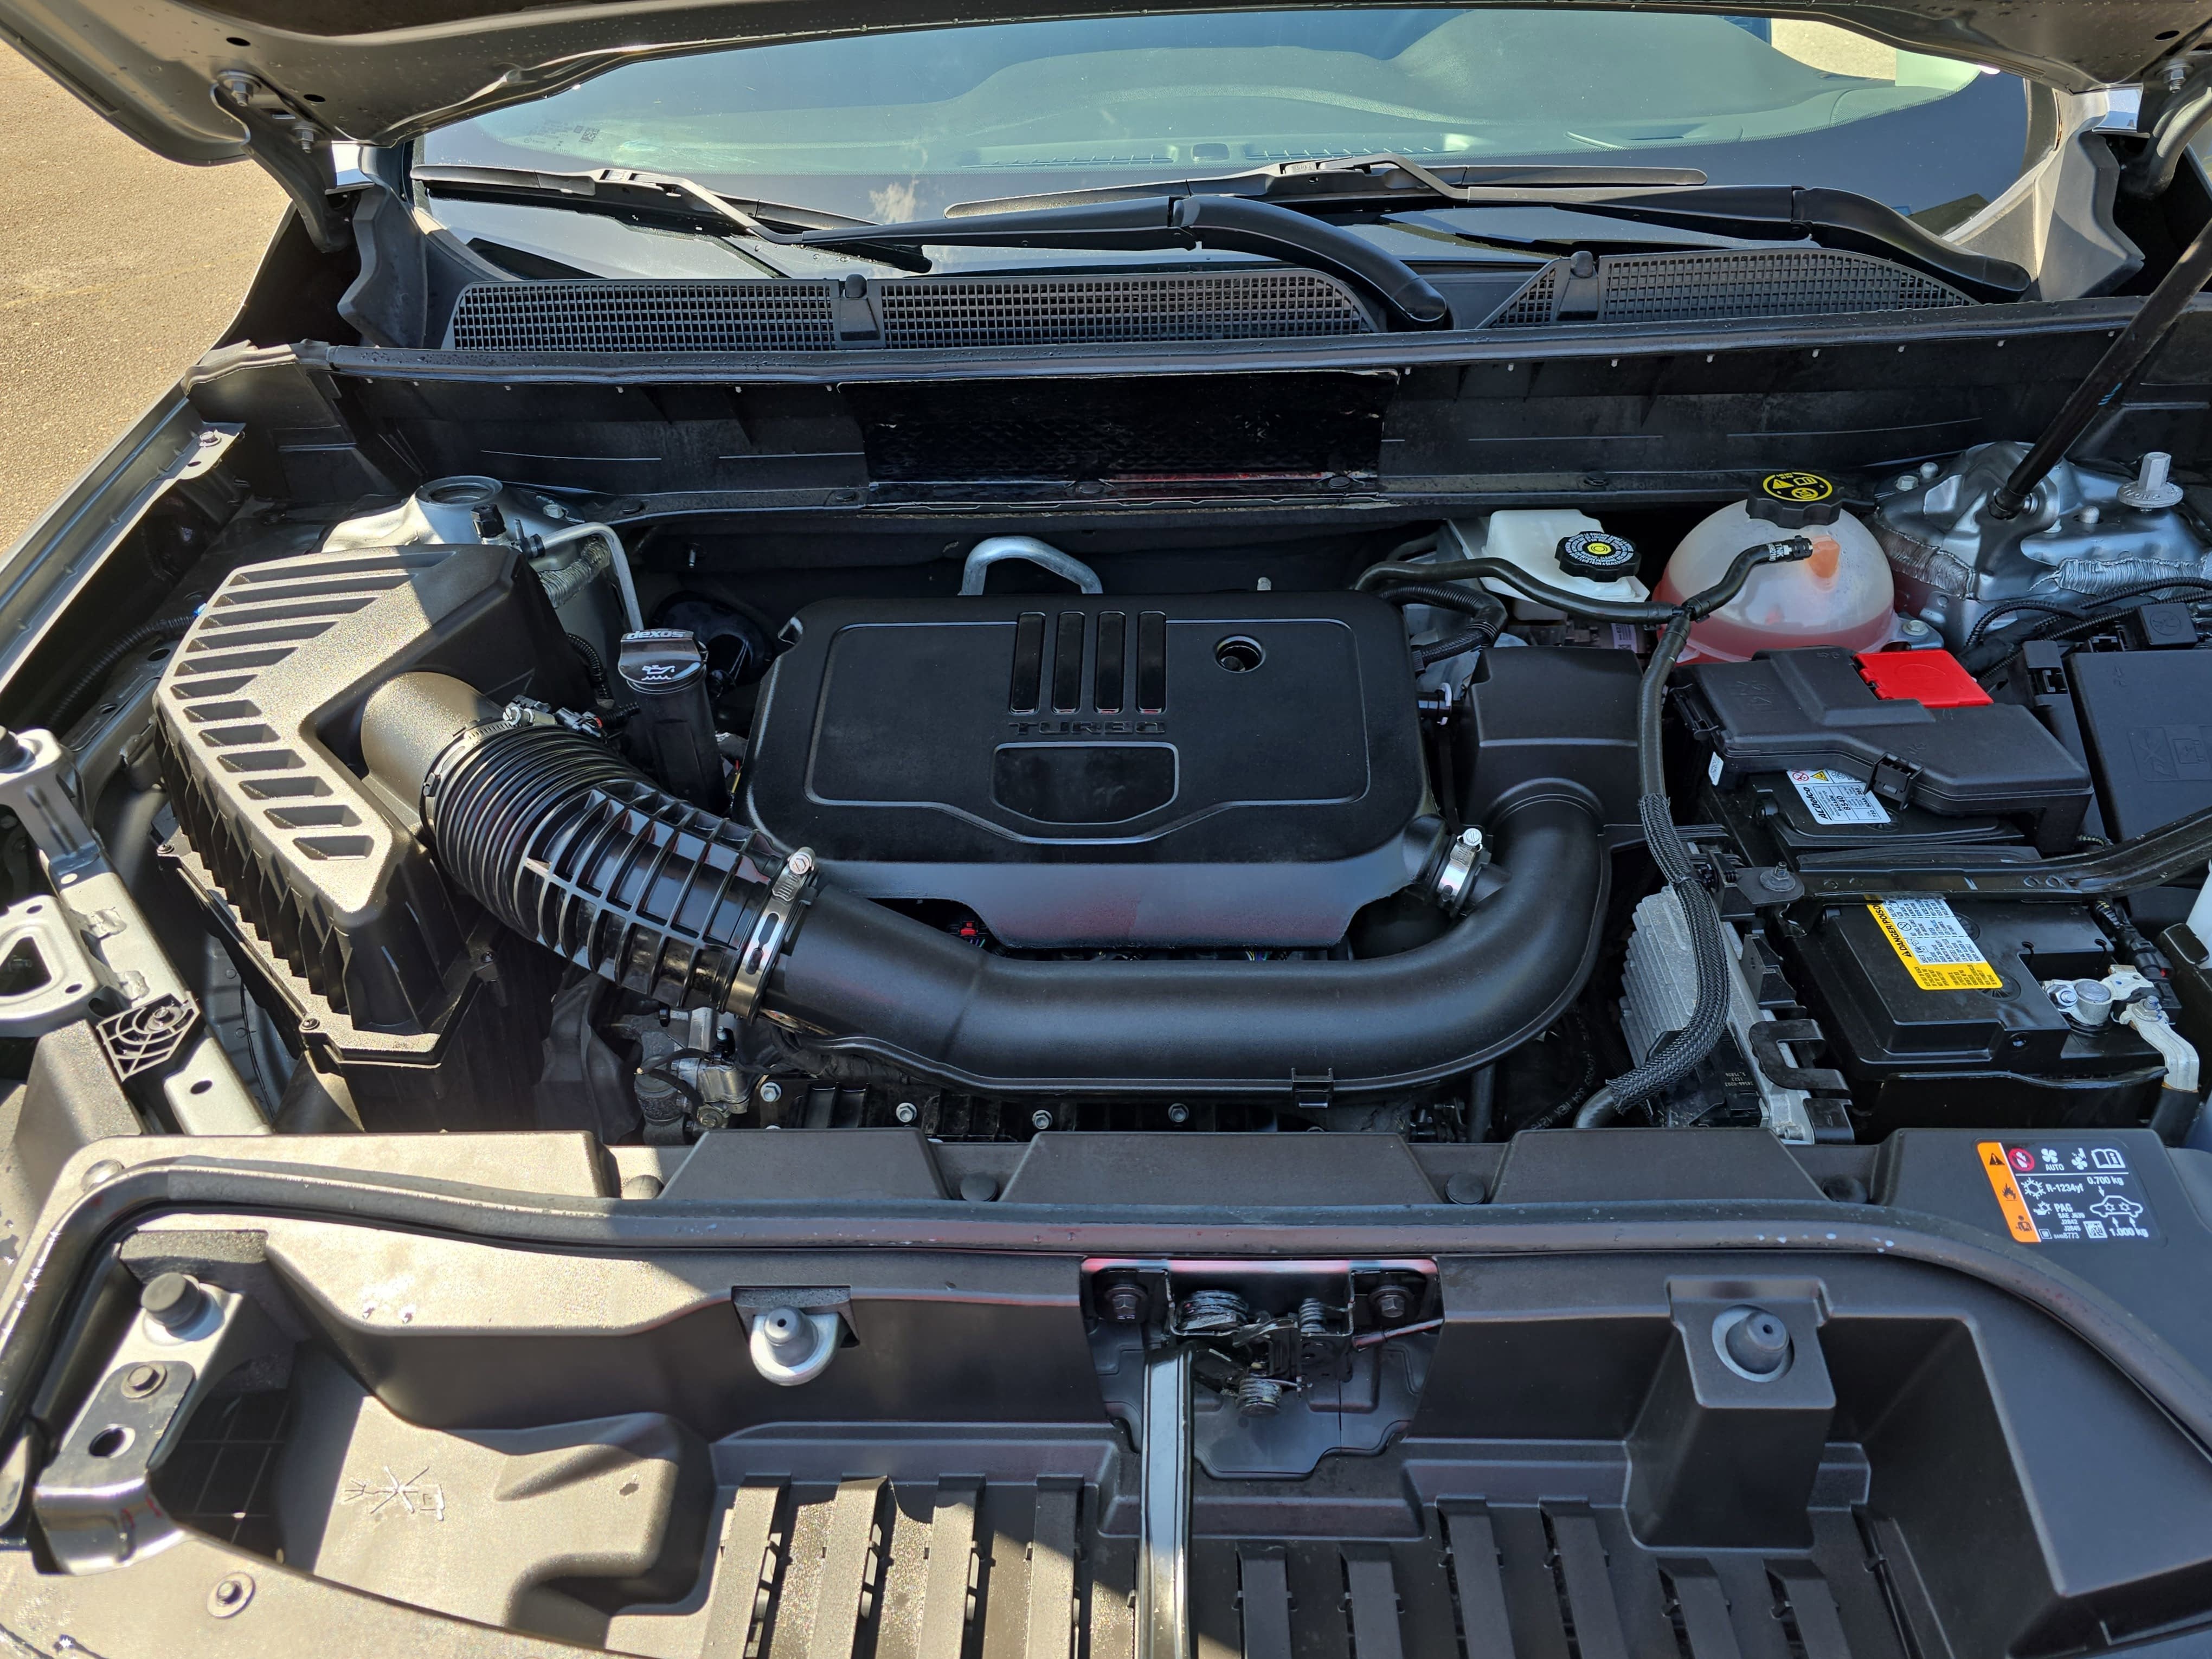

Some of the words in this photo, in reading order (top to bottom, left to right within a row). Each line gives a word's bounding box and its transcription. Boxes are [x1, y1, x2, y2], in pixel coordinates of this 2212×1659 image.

[626, 631, 686, 640] dexos
[1009, 721, 1167, 736] TURBO
[1803, 787, 1828, 820] ACDelco
[1837, 795, 1851, 811] 8540
[2087, 1176, 2111, 1185] 0.700
[2111, 1176, 2124, 1186] kg
[2046, 1184, 2085, 1193] R-1234yf
[2053, 1203, 2073, 1212] PAG
[2108, 1227, 2136, 1236] 1.000
[2134, 1227, 2149, 1238] kg
